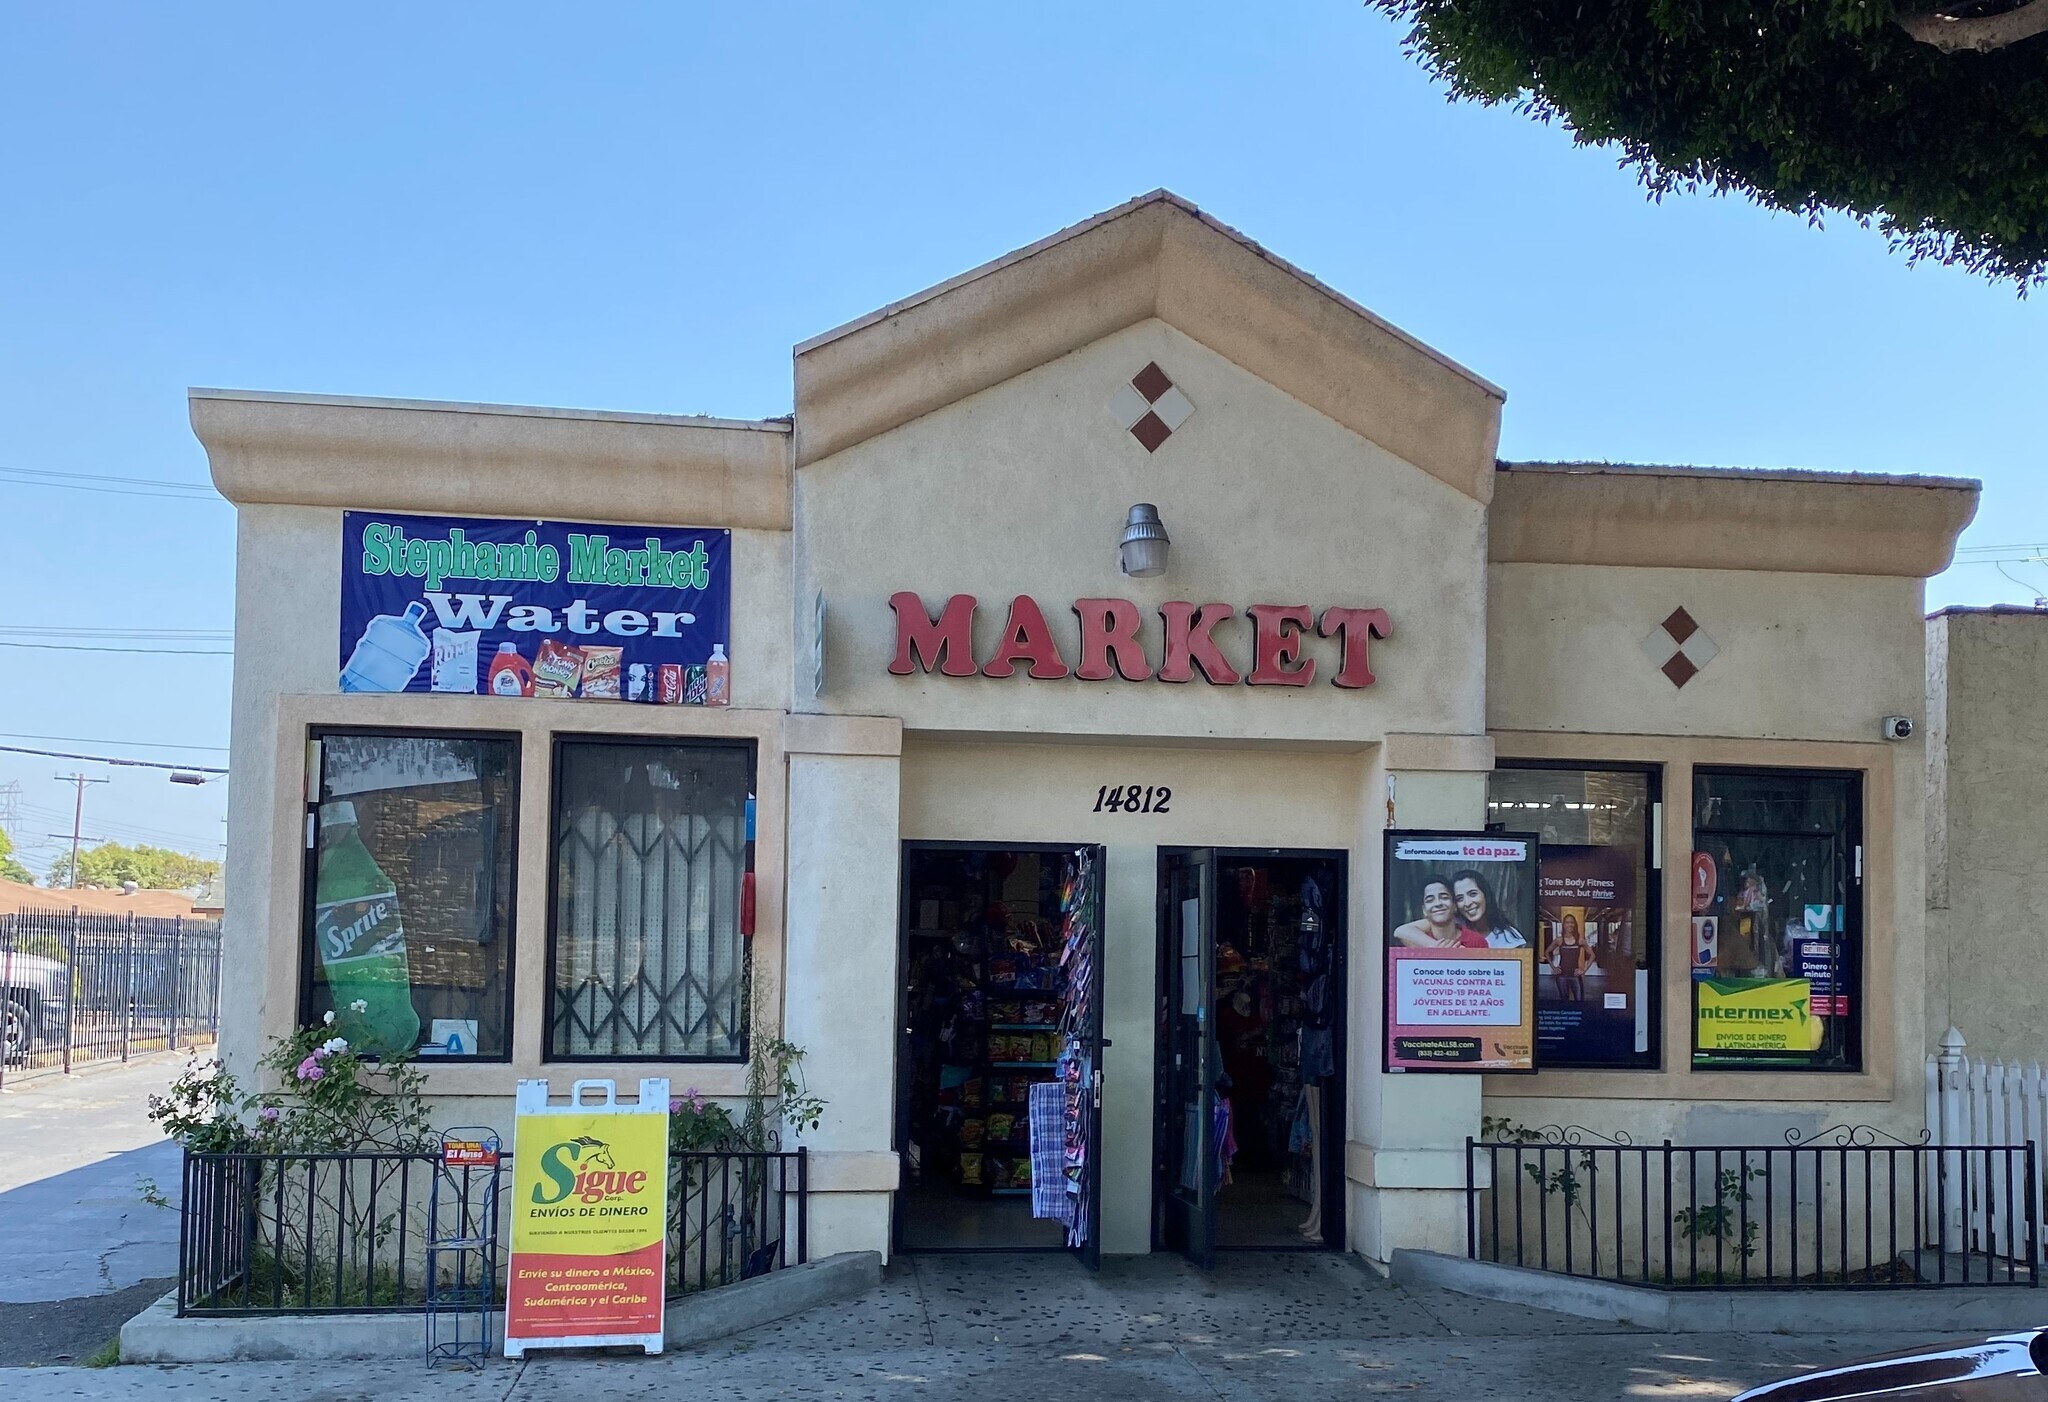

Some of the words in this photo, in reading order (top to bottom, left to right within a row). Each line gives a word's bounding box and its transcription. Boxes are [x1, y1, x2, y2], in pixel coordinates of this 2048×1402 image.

[363, 522, 559, 591] Stephanie
[567, 533, 709, 589] Market
[423, 592, 696, 638] Water
[888, 591, 1392, 688] MARKET
[586, 655, 615, 672] Cheetos
[1093, 785, 1172, 813] 14812
[1463, 846, 1476, 856] te
[1477, 846, 1492, 856] da
[1494, 847, 1520, 858] paz.
[1544, 877, 1564, 886] Tone
[1565, 878, 1585, 888] Body
[1587, 879, 1614, 887] Fitness
[1544, 889, 1575, 897] survive,
[1577, 889, 1591, 897] but
[327, 903, 388, 958] Sprite
[1413, 968, 1444, 976] Conoce
[1447, 968, 1466, 976] todo
[1468, 968, 1491, 976] sobre
[1494, 968, 1505, 976] las
[1413, 997, 1453, 1006] JÓVENES
[1480, 997, 1504, 1006] AÑOS
[1701, 1005, 1793, 1019] ntermex
[447, 1033, 464, 1055] A
[531, 1142, 647, 1204] Sigue
[530, 1206, 575, 1217] ENVÍOS
[579, 1207, 596, 1217] DE
[599, 1206, 648, 1216] DINERO
[518, 1269, 547, 1278] Envíe
[565, 1268, 600, 1278] dinero
[613, 1266, 655, 1277] México,
[545, 1281, 628, 1292] Centroamérica,
[524, 1296, 587, 1307] Sudamérica
[590, 1297, 597, 1307] y
[599, 1295, 609, 1304] el
[612, 1294, 648, 1304] Caribe
